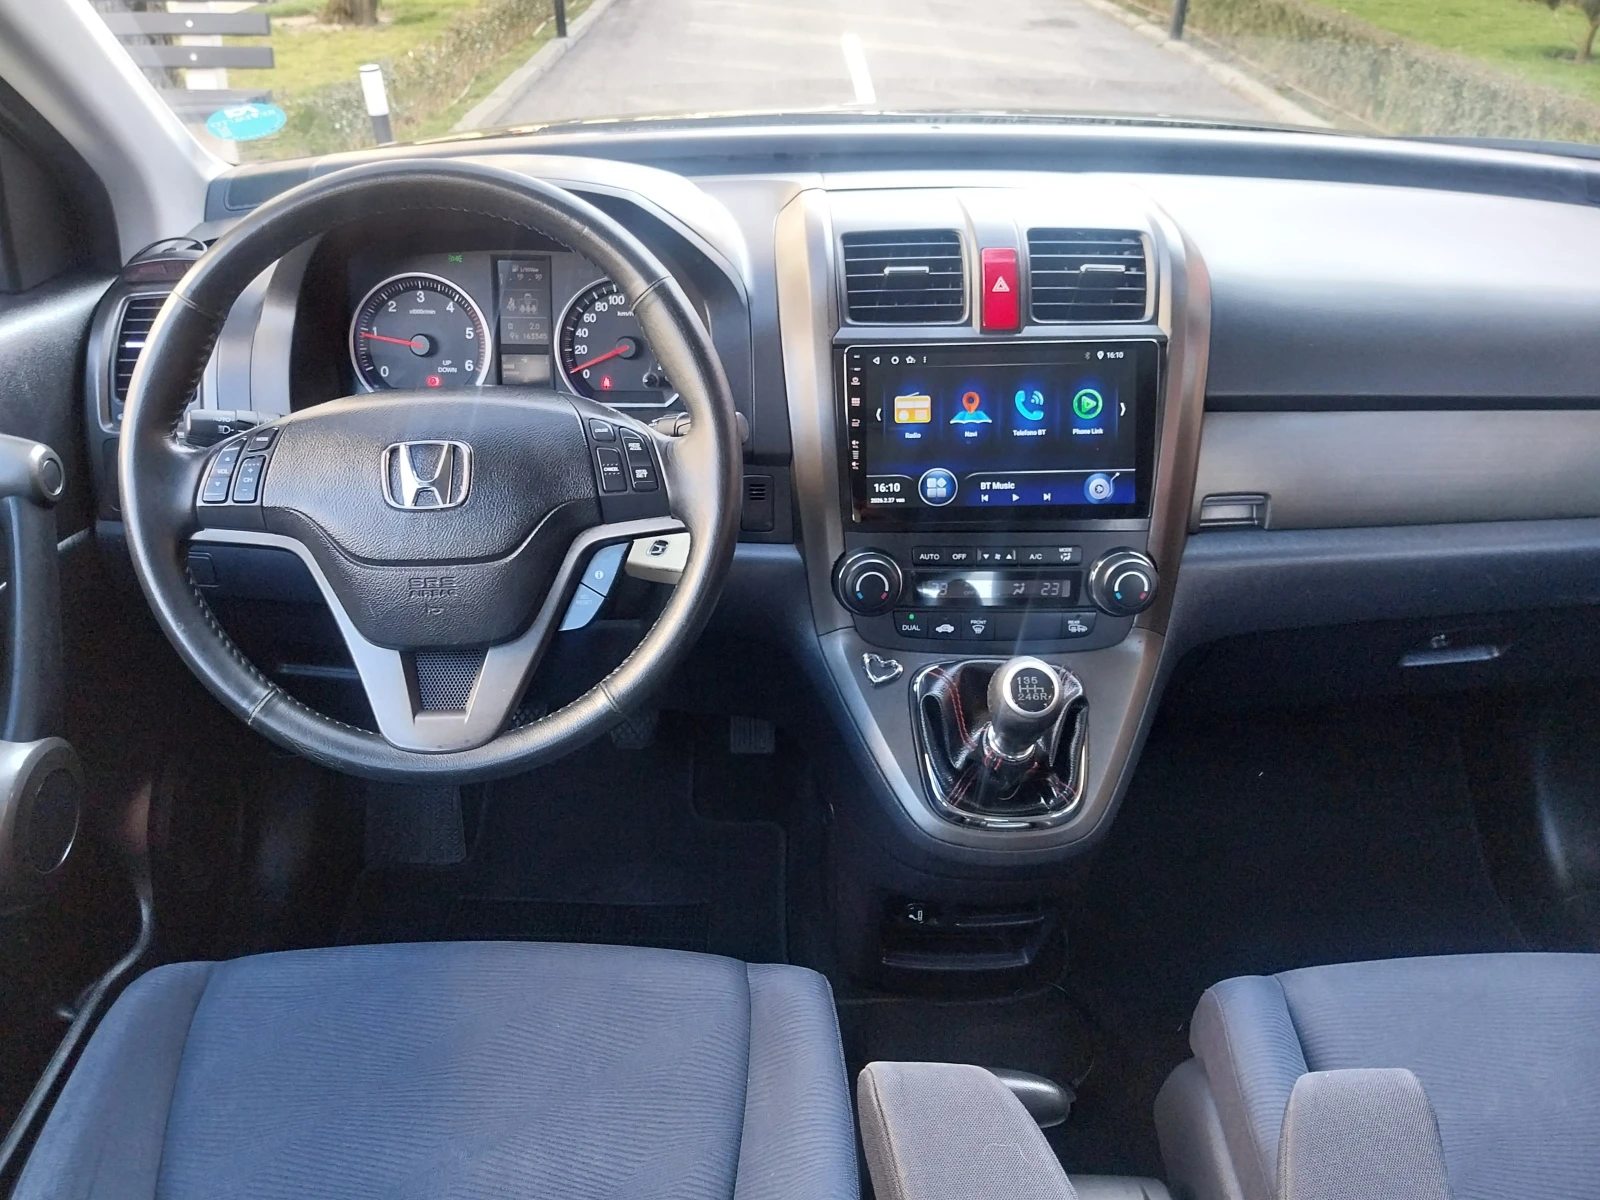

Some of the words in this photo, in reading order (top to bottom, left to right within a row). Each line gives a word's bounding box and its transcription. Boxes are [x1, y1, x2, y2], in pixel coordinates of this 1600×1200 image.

[416, 290, 425, 303] 3
[608, 294, 625, 306] 100
[388, 301, 397, 313] 2
[445, 301, 455, 313] 4
[594, 302, 608, 312] 80
[583, 313, 596, 323] 60
[372, 326, 378, 337] 1
[465, 327, 474, 340] 5
[575, 327, 589, 338] 40
[574, 344, 588, 355] 20
[1106, 351, 1124, 359] 16:10
[464, 360, 474, 372] 6
[380, 366, 389, 378] 0
[582, 369, 591, 379] 0
[905, 432, 922, 440] Radio
[1013, 429, 1036, 437] Telefono
[1037, 428, 1047, 436] BT
[1072, 428, 1089, 436] Phone
[1090, 427, 1104, 435] Link
[873, 482, 901, 493] 16:10
[980, 482, 991, 490] BT
[992, 481, 1015, 490] Music
[1040, 582, 1060, 596] 23
